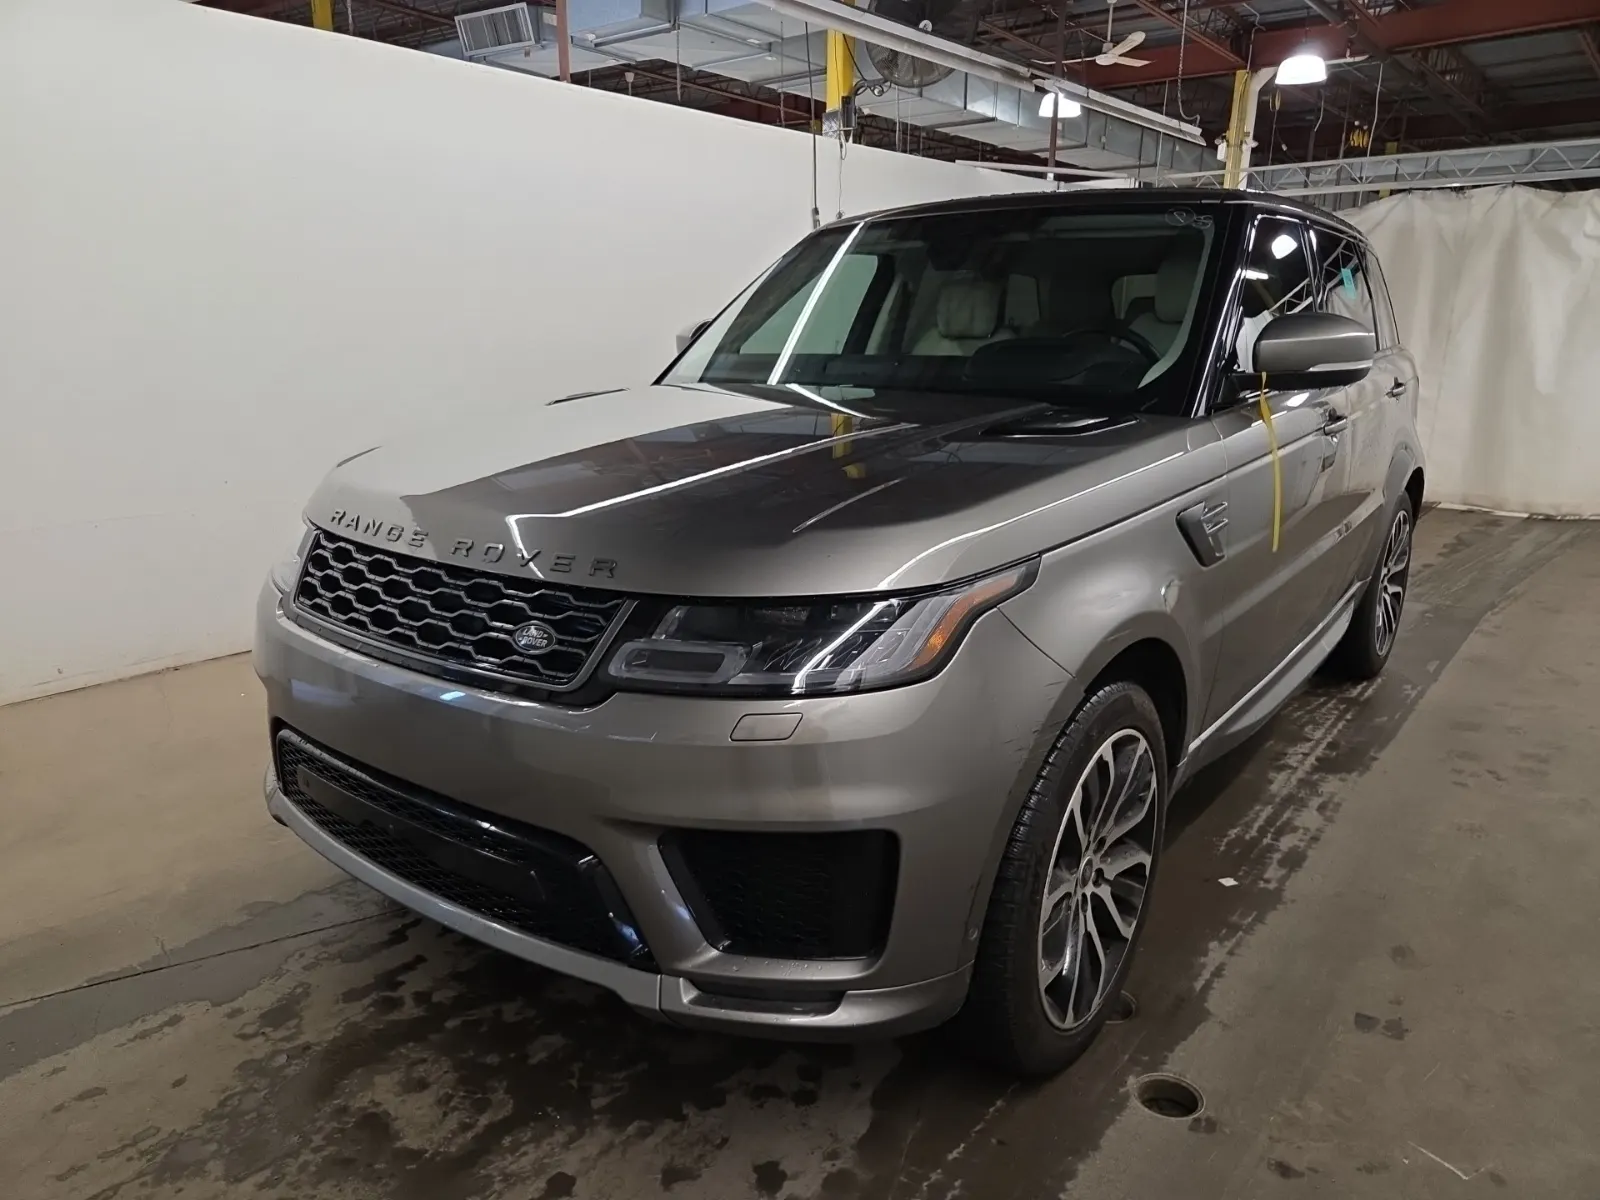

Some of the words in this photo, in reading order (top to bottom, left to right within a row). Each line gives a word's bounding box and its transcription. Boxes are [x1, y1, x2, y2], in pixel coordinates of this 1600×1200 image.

[330, 510, 429, 548] RANGE
[451, 538, 617, 578] ROVER
[523, 628, 544, 638] LAND
[523, 636, 548, 648] ROVER
